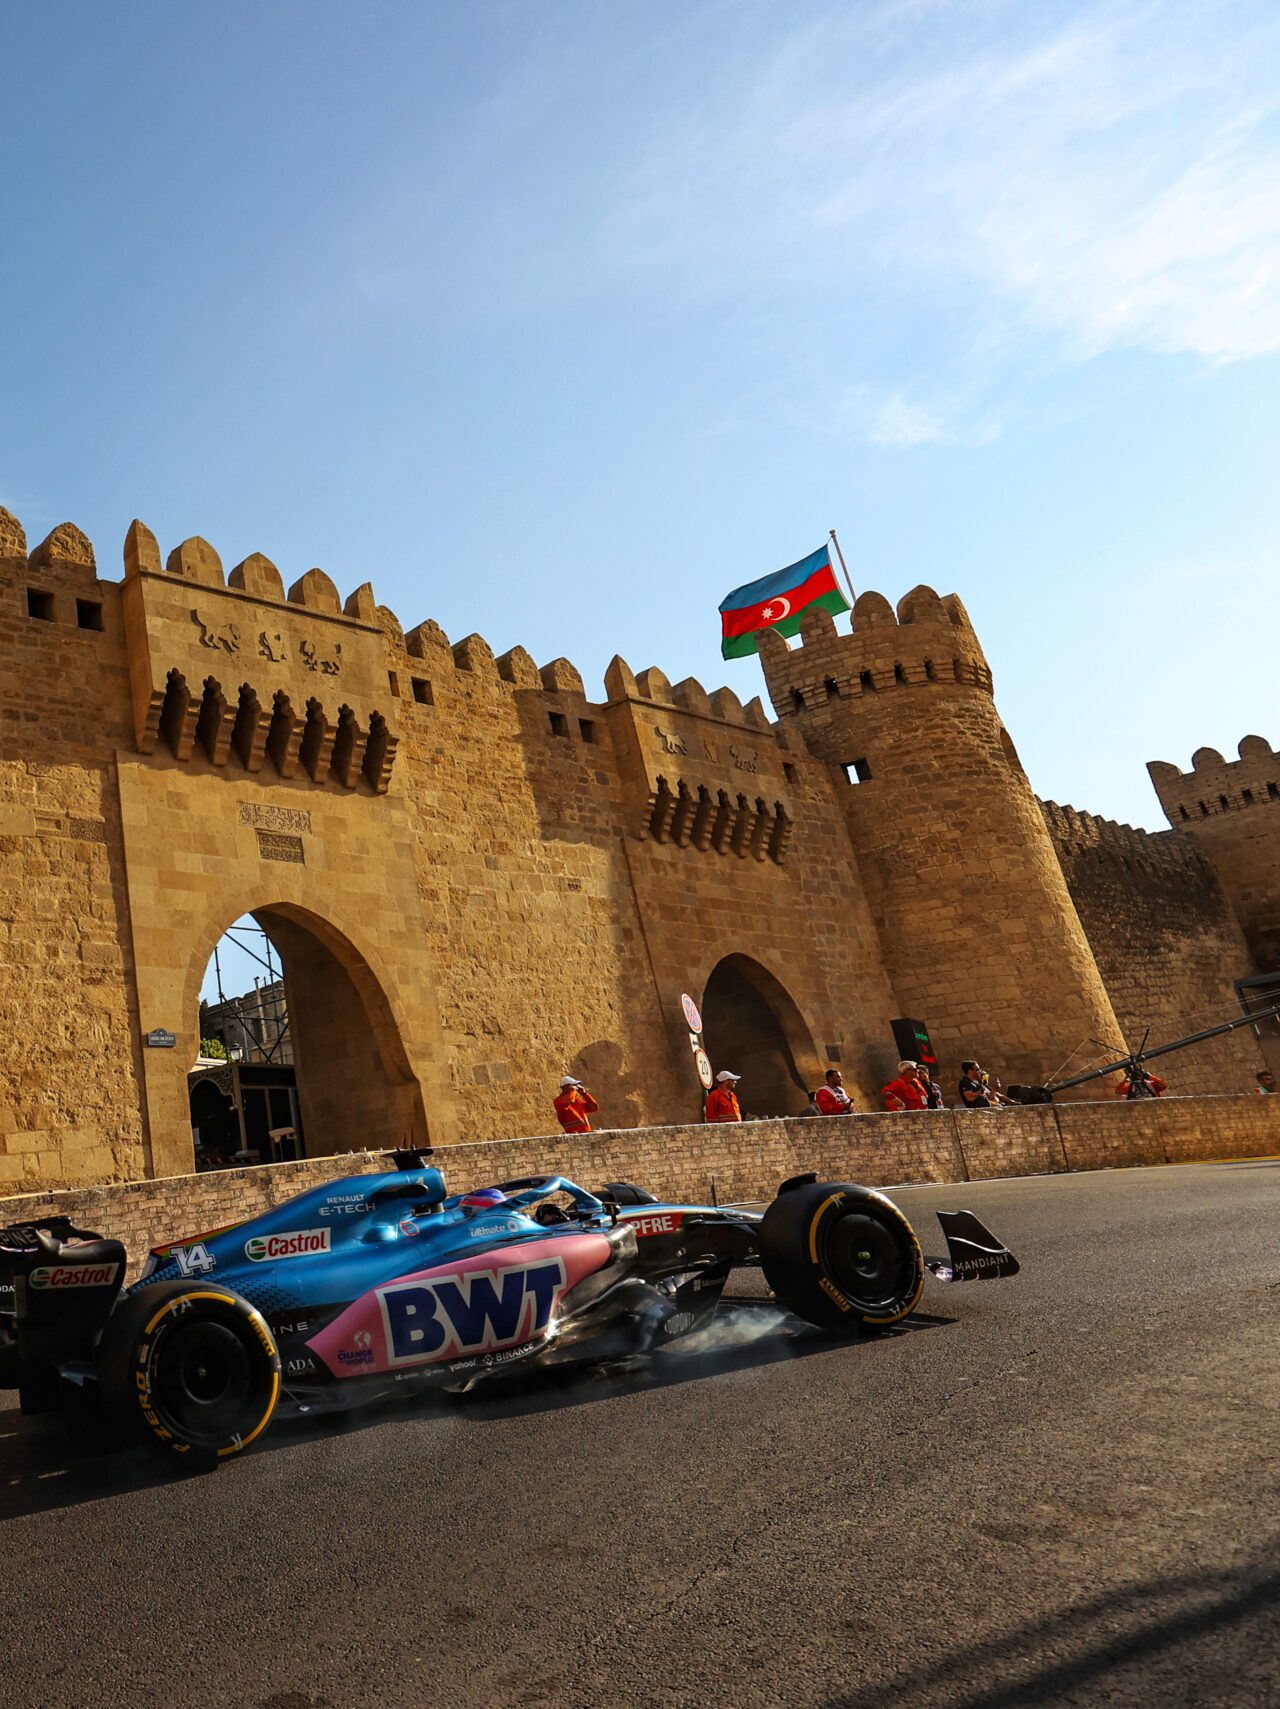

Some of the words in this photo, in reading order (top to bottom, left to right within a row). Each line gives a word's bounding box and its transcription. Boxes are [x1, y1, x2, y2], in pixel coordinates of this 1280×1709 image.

[699, 1060, 709, 1076] 20
[326, 1194, 365, 1205] RENAULT
[318, 1202, 376, 1217] E-TECH
[631, 1215, 674, 1236] PFRE
[267, 1231, 327, 1257] Castrol
[169, 1242, 216, 1278] 14
[954, 1253, 1009, 1273] MANDIANT
[50, 1265, 112, 1286] Castrol
[380, 1259, 566, 1362] BWT
[272, 1321, 309, 1336] INE
[496, 1343, 534, 1362] BINANCE
[287, 1358, 316, 1371] ADA
[449, 1358, 477, 1372] yahoo!
